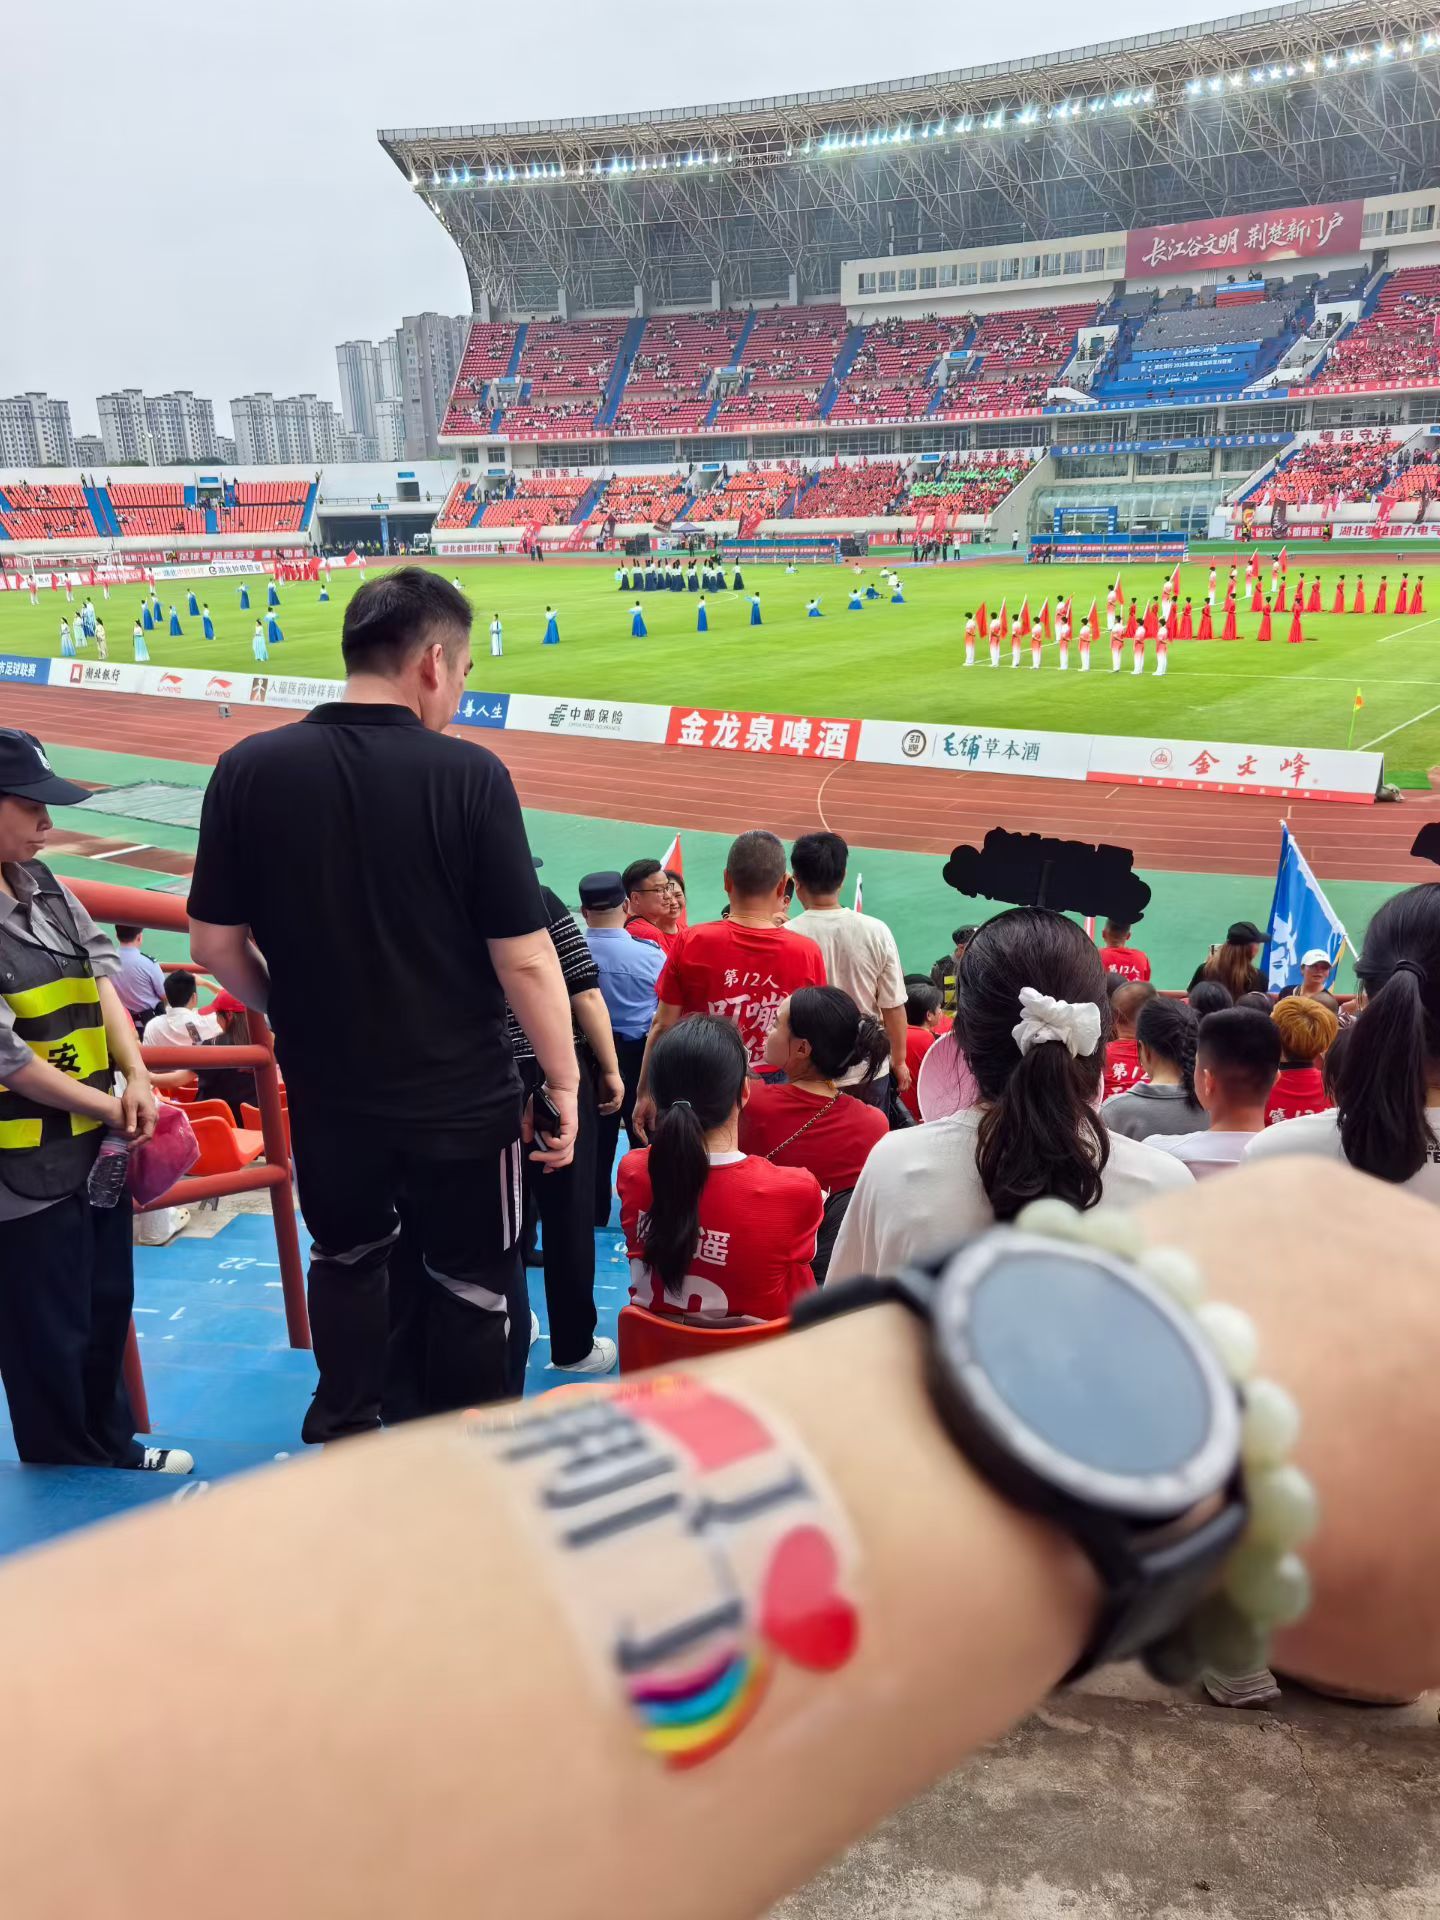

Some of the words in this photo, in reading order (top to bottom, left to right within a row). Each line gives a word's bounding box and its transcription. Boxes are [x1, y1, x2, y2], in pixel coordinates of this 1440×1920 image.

[1141, 227, 1240, 268] 长江谷文明
[1244, 212, 1345, 251] 荆楚新门户
[1319, 427, 1393, 442] 遵纪守法
[531, 467, 585, 479] 祖国至上
[84, 667, 121, 682] 湖北银行
[454, 698, 504, 720] 善人生
[569, 706, 624, 726] 中邮保险
[676, 710, 852, 760] 金龙泉啤酒
[1188, 749, 1312, 788] 金文峰
[723, 968, 780, 989] 第12人
[1108, 963, 1141, 975] 第12人
